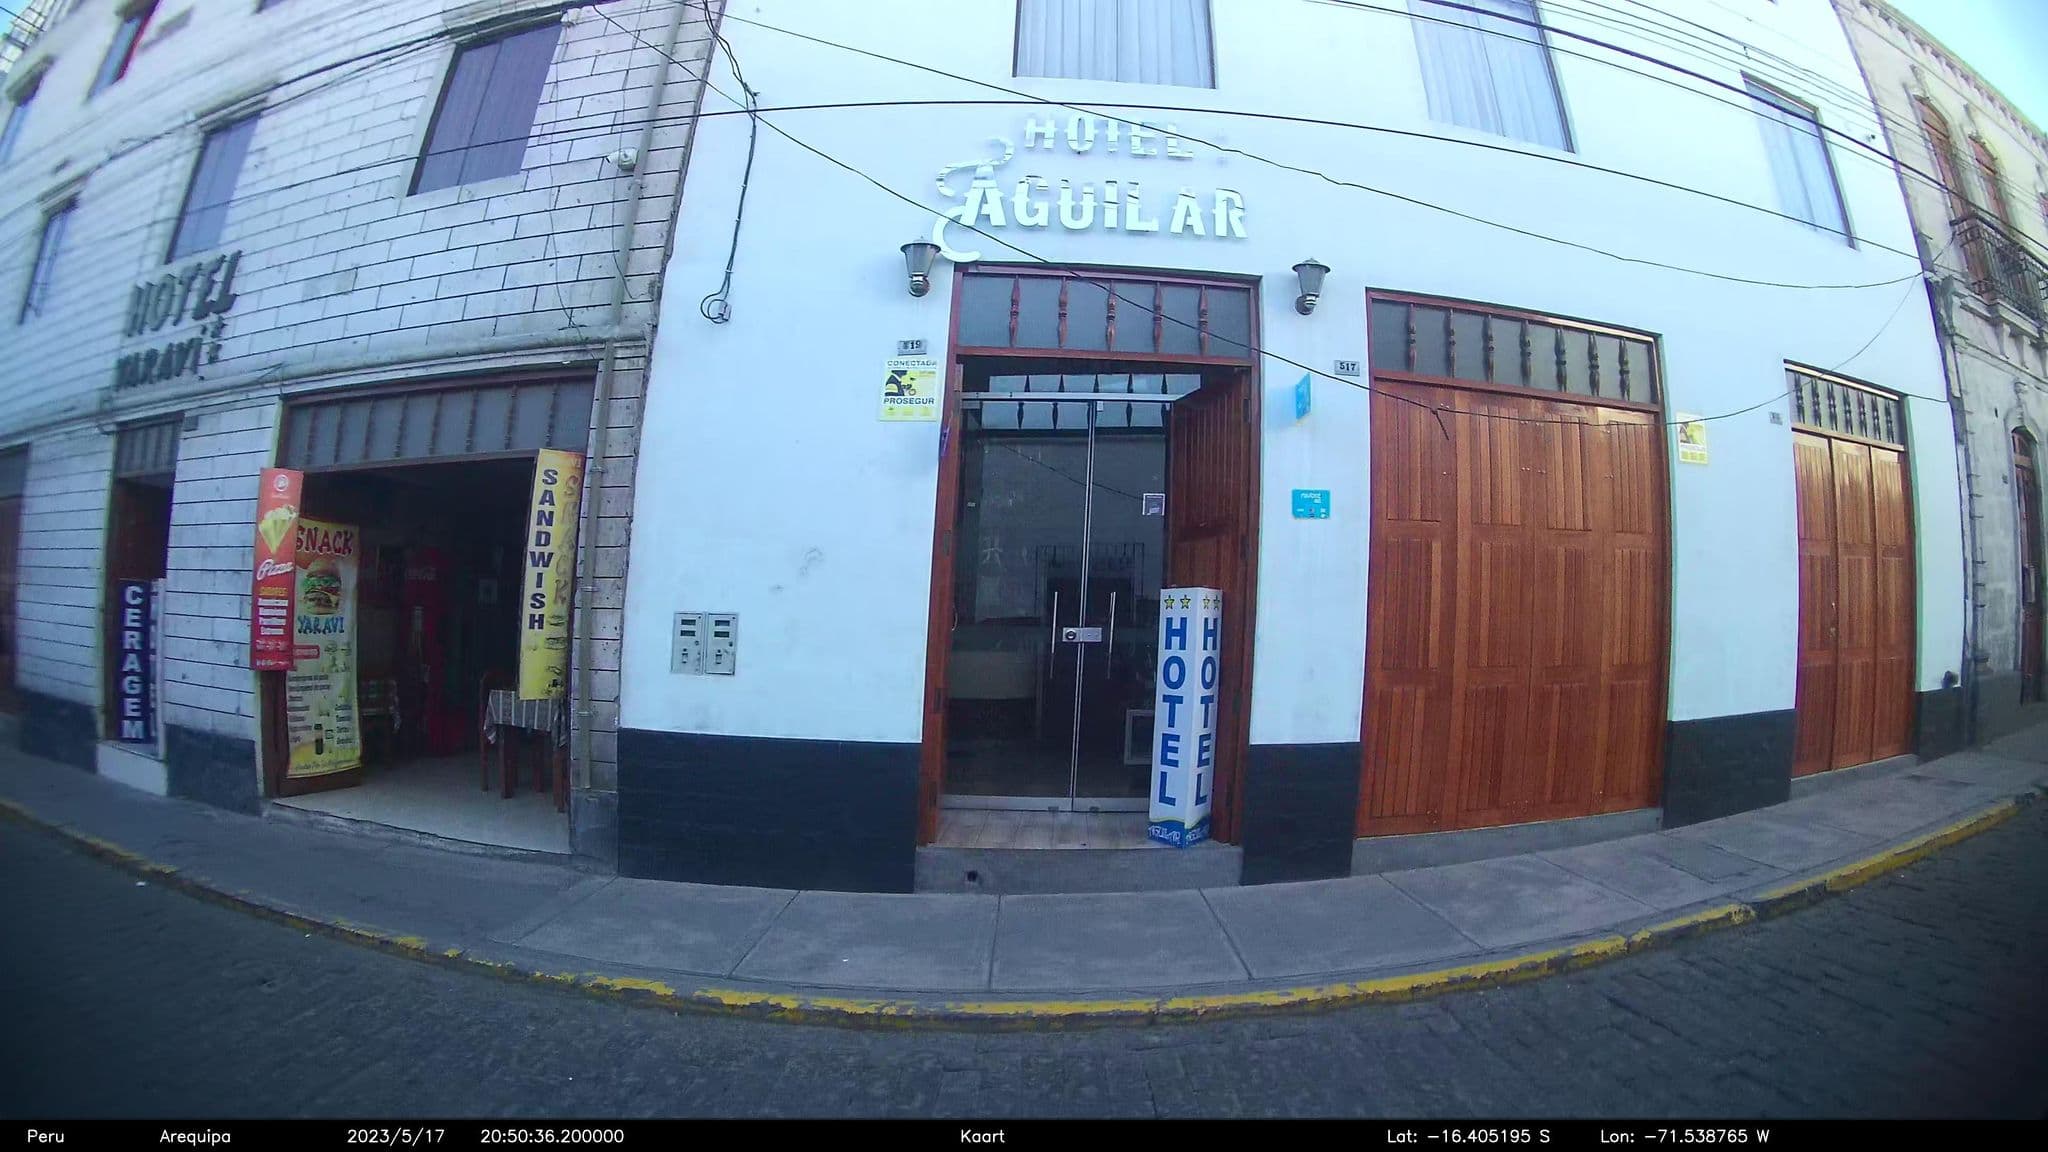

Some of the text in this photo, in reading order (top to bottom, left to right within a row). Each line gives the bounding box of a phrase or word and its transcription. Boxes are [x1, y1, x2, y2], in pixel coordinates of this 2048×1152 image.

[1023, 111, 1194, 159] HOTEL
[932, 136, 1249, 262] AGUILAR
[126, 250, 241, 337] HOTEL
[883, 397, 935, 405] PROSEGUR
[1339, 361, 1357, 371] 517
[296, 524, 353, 556] SNACK
[528, 468, 559, 630] SANDWISH
[121, 585, 145, 739] CERAGEM
[297, 615, 345, 635] YARAVI
[1159, 617, 1188, 806] HOTEL
[1195, 617, 1217, 806] HOTEL
